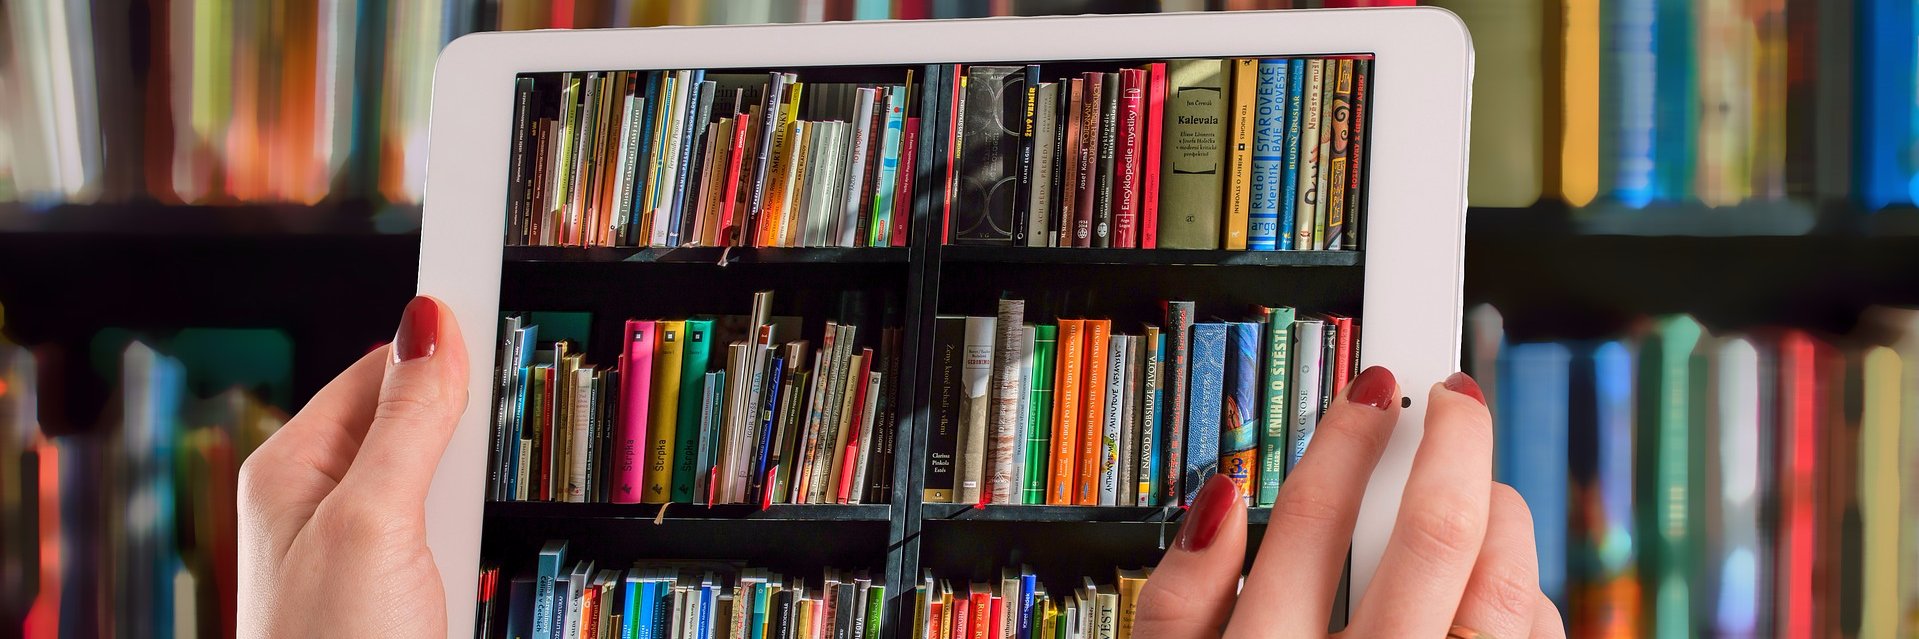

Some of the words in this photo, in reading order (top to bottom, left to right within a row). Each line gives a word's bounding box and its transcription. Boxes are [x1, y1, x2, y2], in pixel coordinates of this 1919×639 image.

[1026, 86, 1036, 116] VESMÍR
[1274, 66, 1286, 110] POVĚSTI
[1109, 98, 1117, 132] mytologie
[1178, 115, 1218, 125] Kalevala
[1257, 65, 1275, 152] STAROVĚKÉ
[671, 118, 681, 139] Pessoa
[775, 110, 787, 148] MILENKY
[1025, 118, 1034, 137] ŽIVÝ
[1101, 112, 1110, 158] Encyklopedie
[1125, 109, 1136, 146] mystiky
[1239, 116, 1247, 140] HUGHES
[1272, 127, 1283, 152] BÁJE
[667, 140, 678, 170] Fernando
[1080, 147, 1089, 170] Kolmaš
[1107, 134, 1115, 158] baltské
[1289, 135, 1298, 169] BLUDNÝ
[1080, 172, 1088, 190] Josef
[1122, 147, 1135, 210] Encyklopedie
[1351, 143, 1361, 189] ROZPRÁVKY
[765, 191, 775, 211] Maria
[1252, 162, 1265, 209] Rudolf
[1267, 163, 1280, 209] Mertlík
[762, 210, 773, 231] Rainer
[1251, 222, 1276, 235] argo
[1067, 324, 1077, 358] INKOGNITO
[1272, 329, 1287, 376] ŠTĚSTÍ
[1146, 355, 1157, 387] ŽIVOTA
[746, 420, 756, 438] IGOR
[751, 370, 761, 394] ALBA
[1109, 388, 1120, 429] MINUTOVÉ
[1144, 389, 1155, 427] OBSLUZE
[1269, 394, 1283, 437] KNIHA
[1299, 389, 1309, 425] GNOSE
[653, 438, 668, 472] Štrpka
[1142, 437, 1152, 469] NÁVOD
[1105, 461, 1115, 492] ANTHONY
[538, 575, 547, 597] Céline
[545, 575, 554, 593] Anna
[535, 604, 544, 632] Čechách
